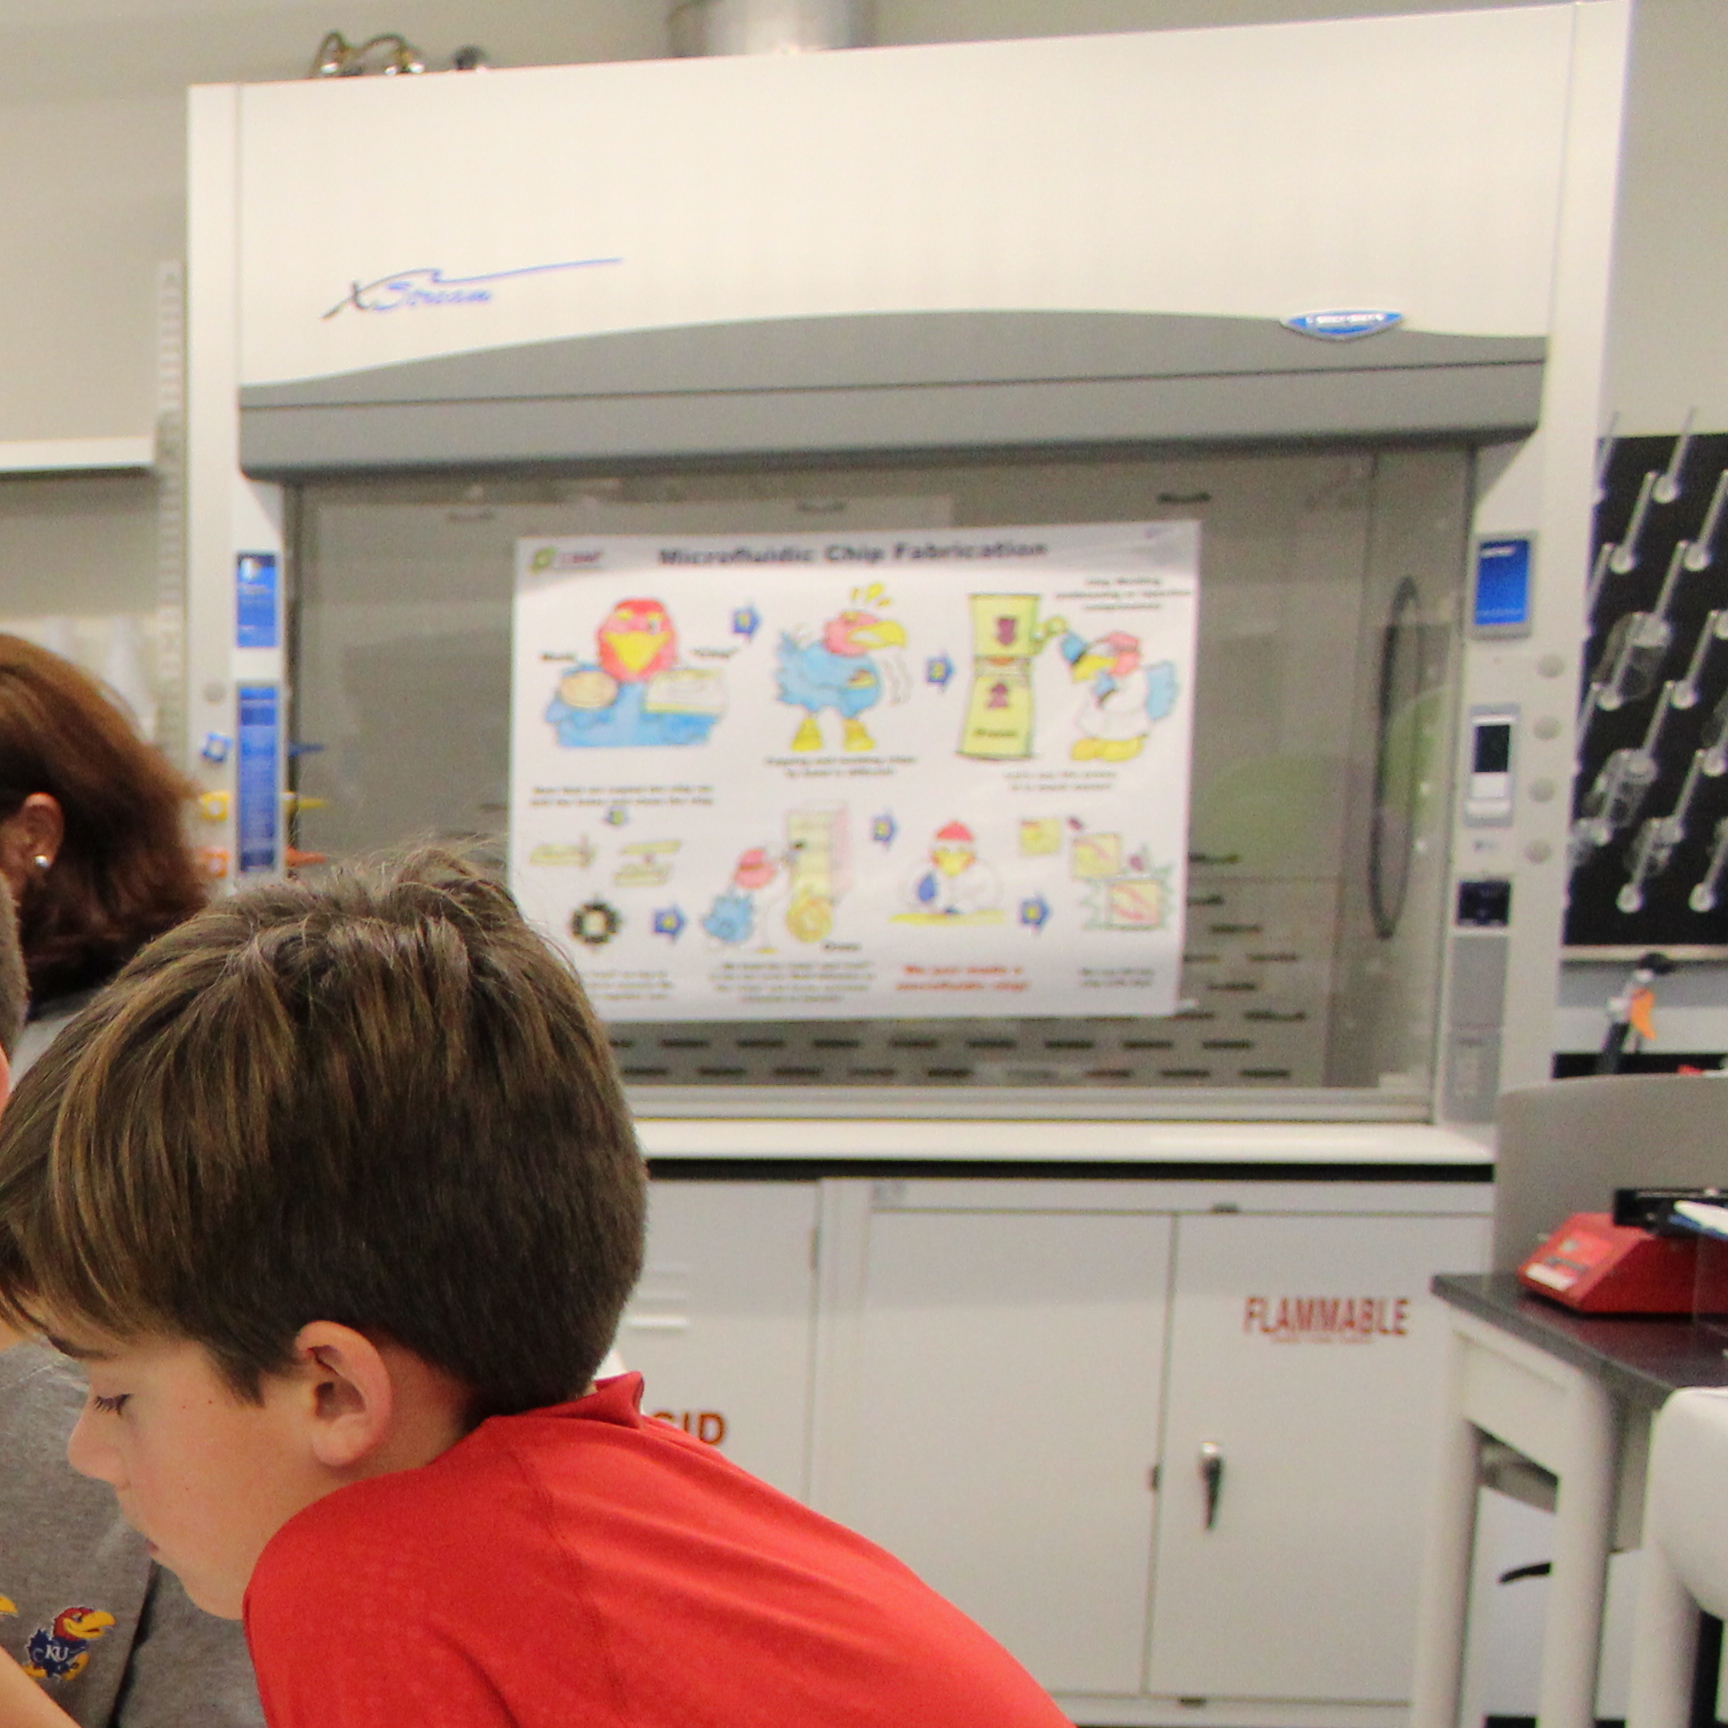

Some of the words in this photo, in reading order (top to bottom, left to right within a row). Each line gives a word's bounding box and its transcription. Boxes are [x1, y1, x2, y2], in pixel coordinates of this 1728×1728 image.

[658, 546, 814, 565] Microfluidic
[824, 544, 884, 564] Chip
[894, 541, 1048, 560] Fabrication
[1243, 1297, 1410, 1335] FLAMMABLE
[45, 1645, 69, 1662] KU
